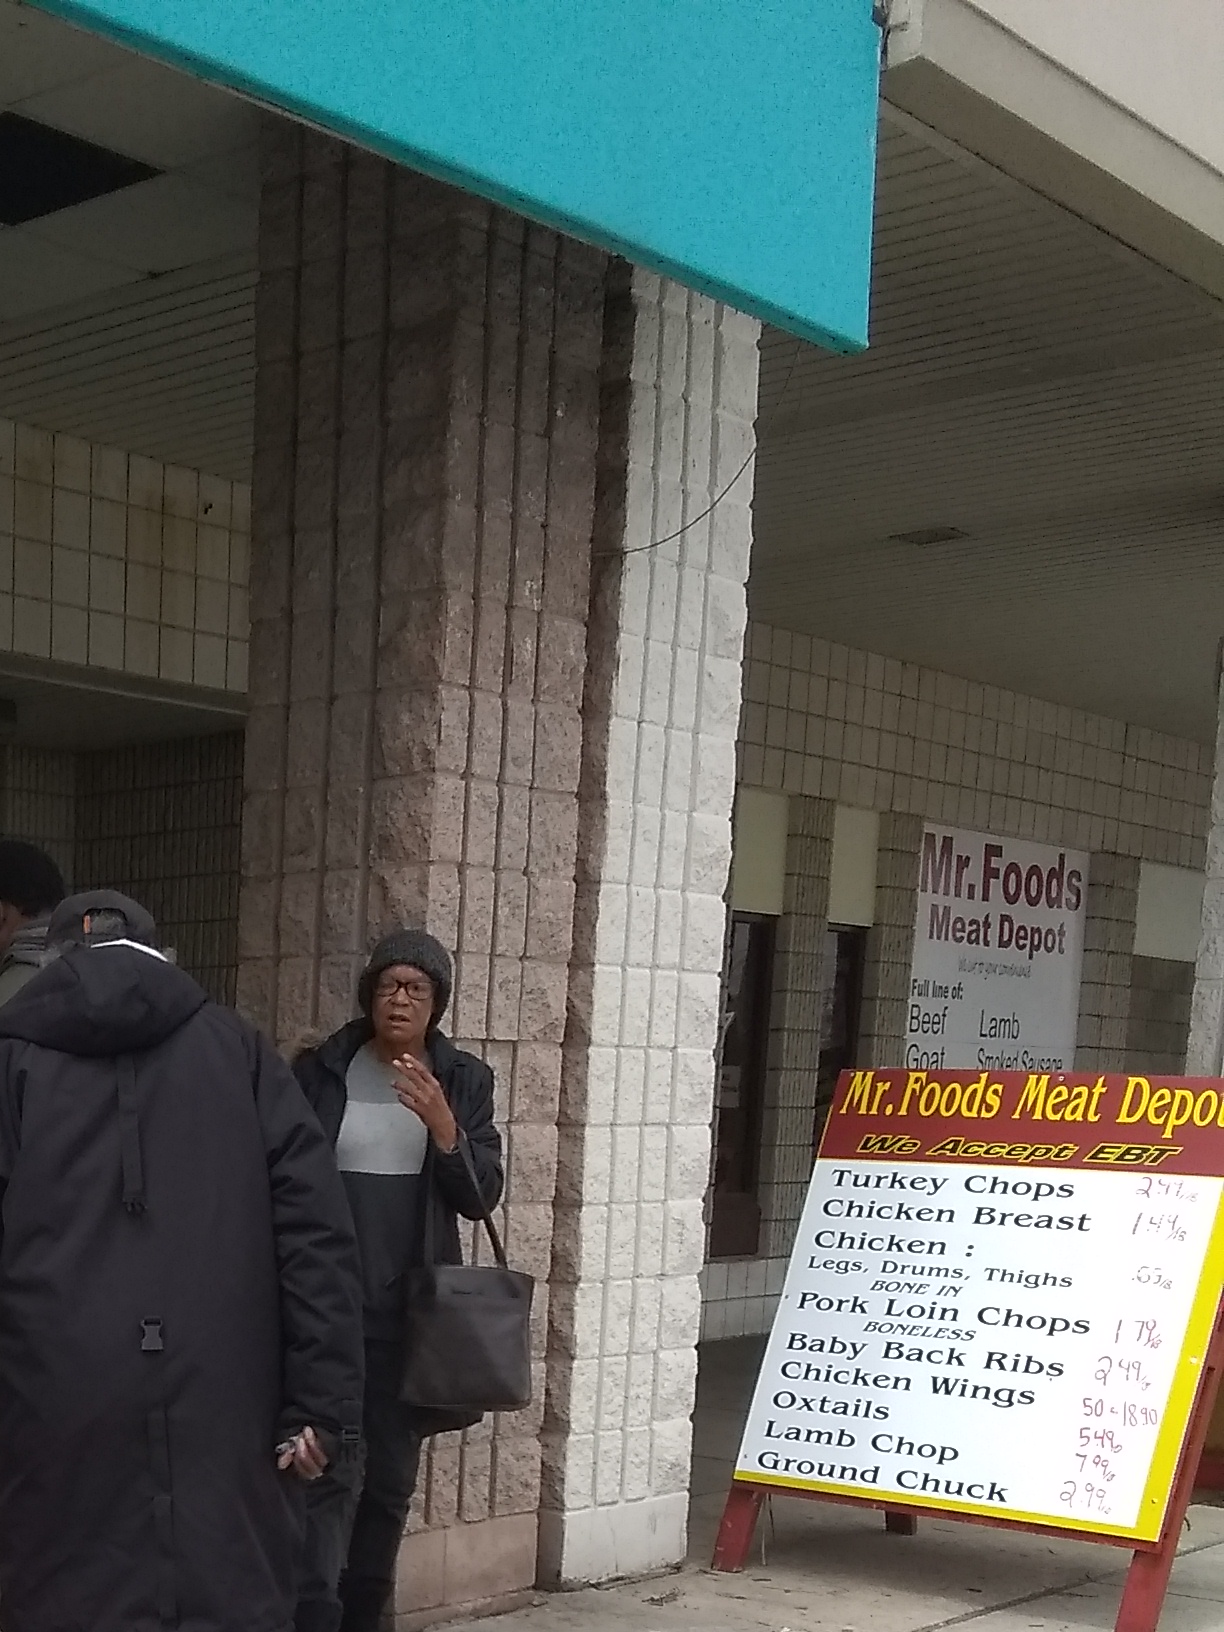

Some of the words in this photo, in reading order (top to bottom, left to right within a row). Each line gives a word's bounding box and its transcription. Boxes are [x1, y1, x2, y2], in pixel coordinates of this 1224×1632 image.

[929, 903, 991, 947] Meat
[997, 913, 1066, 960] Depot
[911, 979, 930, 997] Full
[932, 980, 949, 999] line
[909, 1004, 948, 1034] Beef
[979, 1009, 1020, 1039] Lamb
[906, 1044, 945, 1070] Goat
[977, 1048, 1019, 1071] Smoked
[1012, 1075, 1107, 1122] Meat
[856, 1134, 921, 1154] We
[926, 1137, 1079, 1163] Accept
[1083, 1143, 1184, 1165] EBT
[832, 1169, 949, 1196] Turkey
[964, 1175, 1074, 1201] Chops
[823, 1199, 955, 1223] Chicken
[972, 1207, 1091, 1232] Breast
[814, 1230, 947, 1255] Chicken
[808, 1256, 868, 1274] Legs,
[881, 1260, 970, 1280] Drums,
[984, 1268, 1072, 1288] Thighs
[870, 1280, 930, 1295] BONE
[936, 1285, 963, 1298] IN
[796, 1292, 869, 1315] Pork
[884, 1298, 959, 1322] Loin
[977, 1306, 1090, 1336] Chops
[862, 1321, 977, 1341] BONELESS
[786, 1333, 868, 1360] Baby
[881, 1341, 966, 1367] Back
[983, 1351, 1064, 1376] Ribs
[780, 1361, 912, 1391] Chicken
[930, 1375, 1035, 1408] Wings
[773, 1391, 890, 1420] Oxtails
[764, 1420, 856, 1447] Lamb
[871, 1434, 959, 1465] Chop
[758, 1451, 880, 1484] Ground
[896, 1470, 1008, 1502] Chuck
